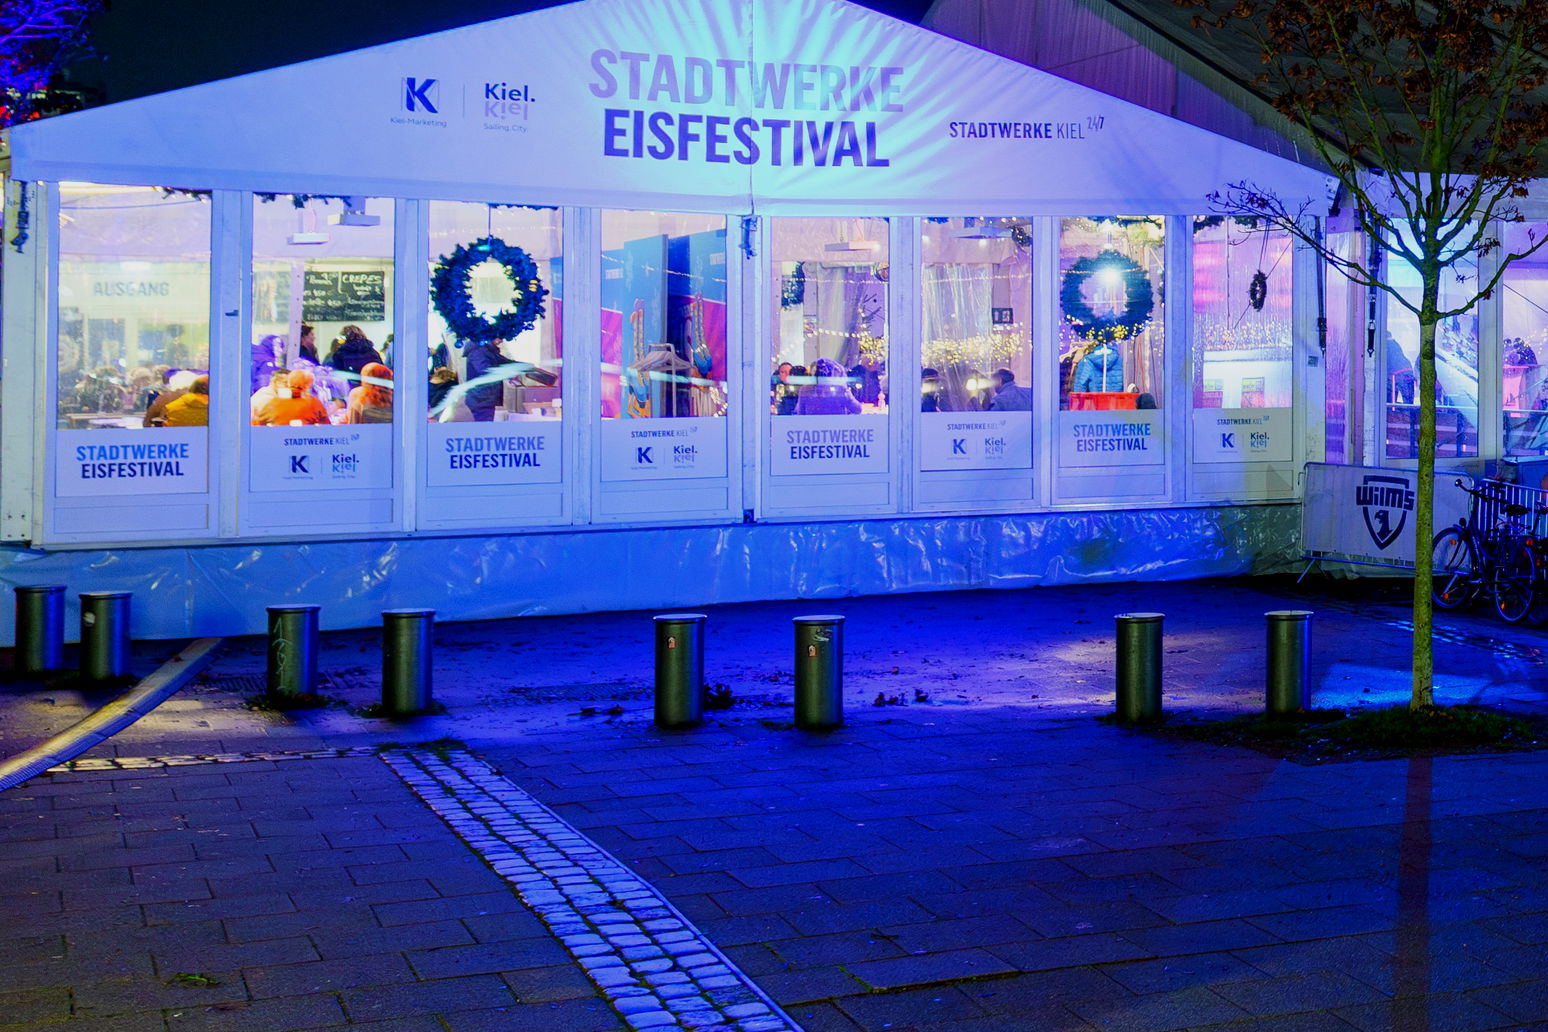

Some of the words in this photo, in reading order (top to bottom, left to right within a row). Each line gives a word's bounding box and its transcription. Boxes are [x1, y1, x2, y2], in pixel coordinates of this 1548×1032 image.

[588, 48, 905, 113] STADTWERKE
[484, 82, 536, 103] Kiel.
[603, 108, 891, 168] EISFESTIVAL
[949, 121, 1053, 139] STADTWERKE
[1056, 122, 1086, 140] KIEL
[93, 281, 170, 298] AUSGANG
[785, 429, 875, 445] STADTWERKE
[1072, 422, 1152, 437] STADTWERKE
[75, 442, 190, 463] STADTWERKE
[445, 435, 545, 454] STADTWERKE
[789, 444, 871, 460] EISFESTIVAL
[1076, 437, 1148, 453] EISFESTIVAL
[80, 460, 185, 480] EISFESTIVAL
[449, 452, 541, 470] EISFESTIVAL
